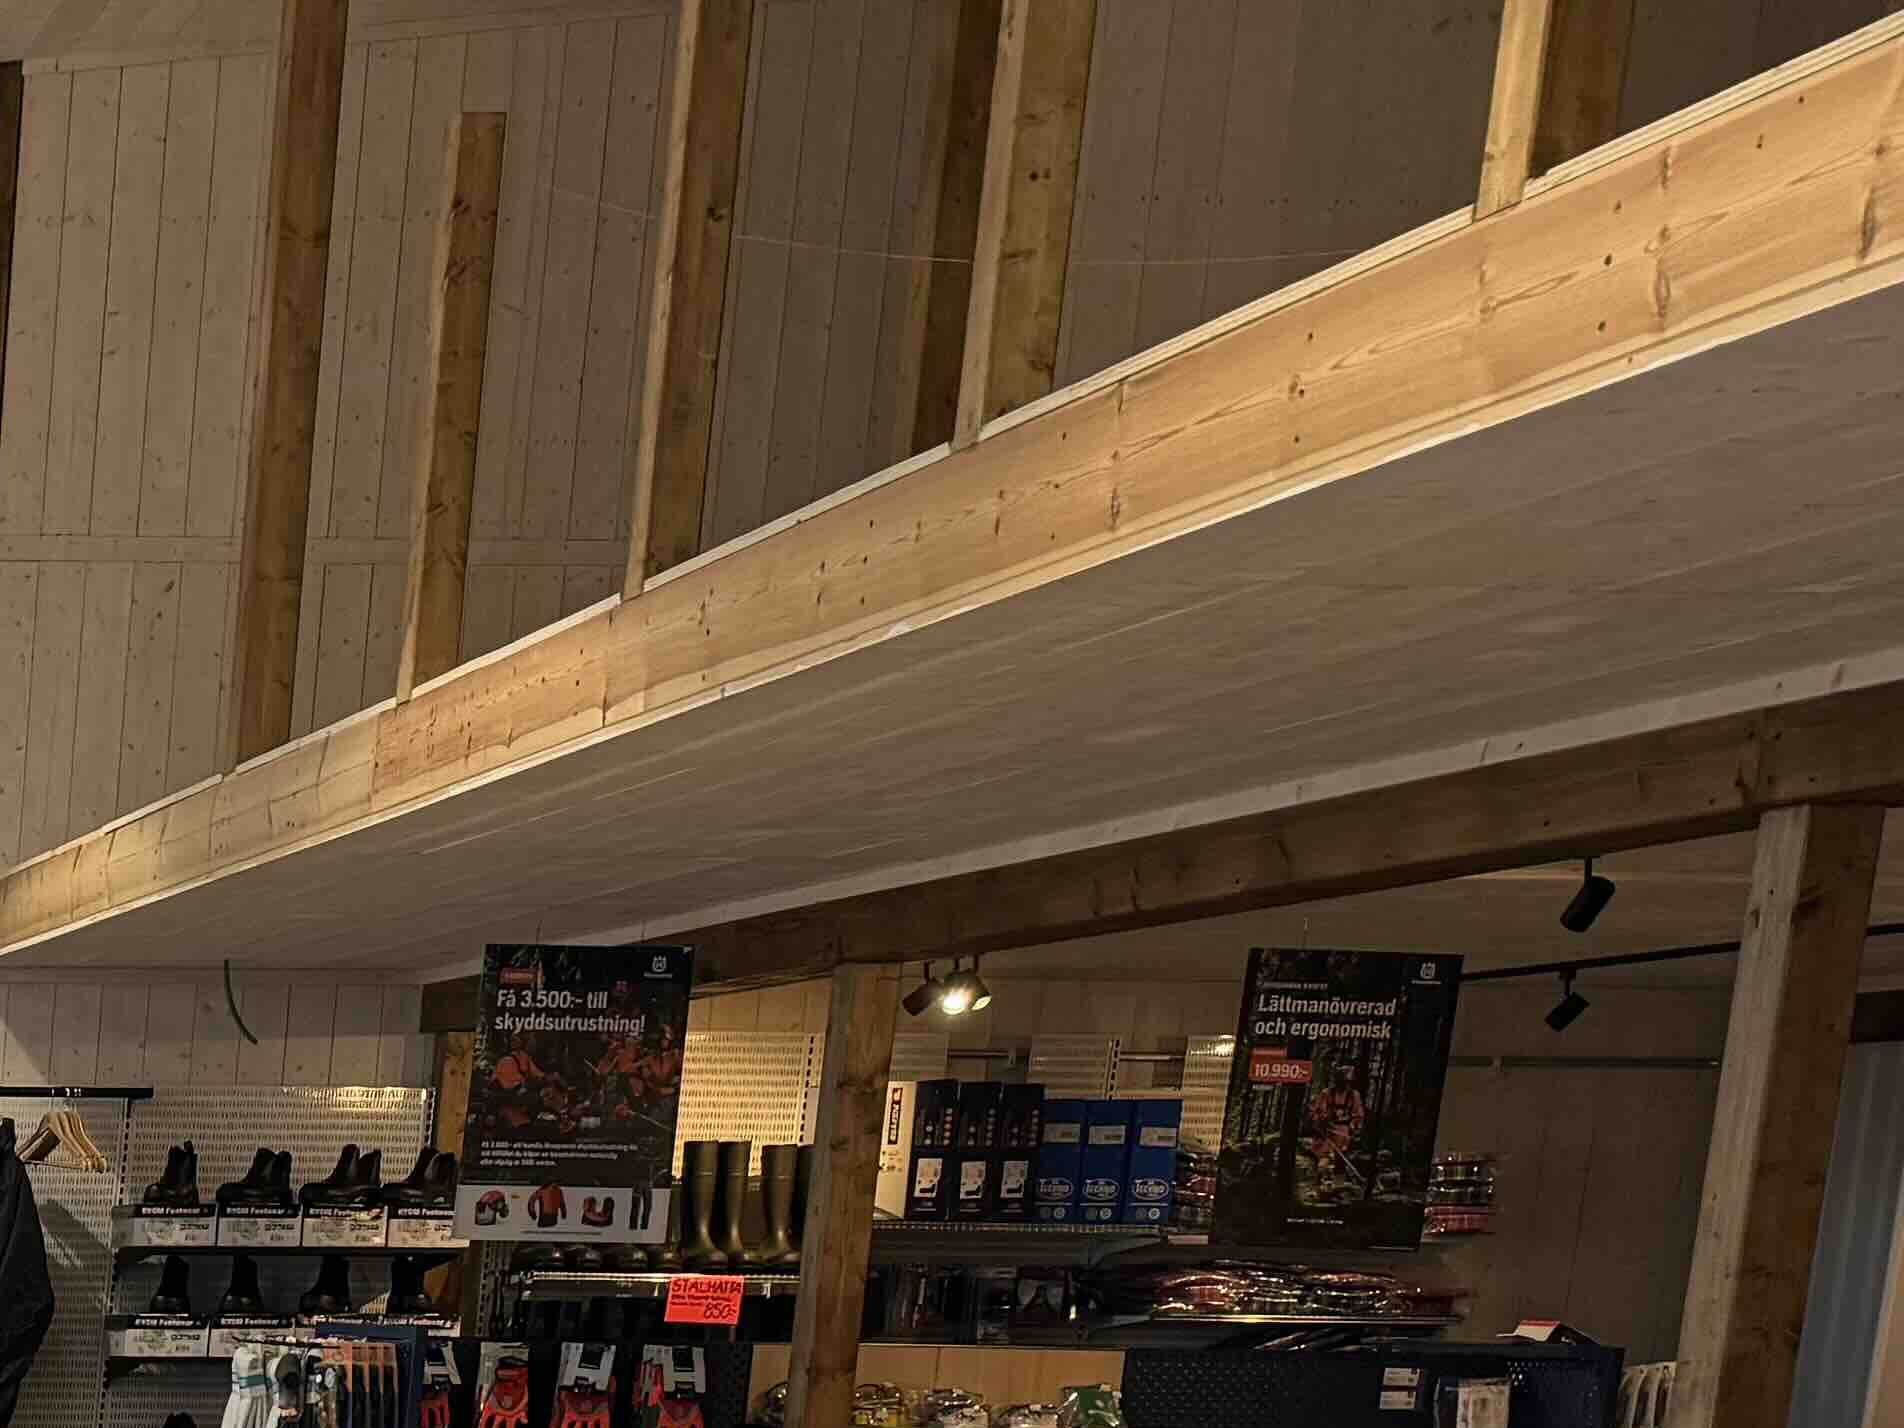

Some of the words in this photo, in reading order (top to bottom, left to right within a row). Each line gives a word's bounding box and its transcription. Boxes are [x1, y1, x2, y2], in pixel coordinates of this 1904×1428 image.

[497, 990, 516, 1008] Få
[520, 991, 583, 1009] 3.500:-
[587, 991, 608, 1009] till
[1258, 995, 1397, 1017] Lättmanövrerad
[495, 1013, 645, 1036] skyddsutrustning!
[1255, 1018, 1286, 1036] och
[1291, 1021, 1391, 1040] ergonomisk
